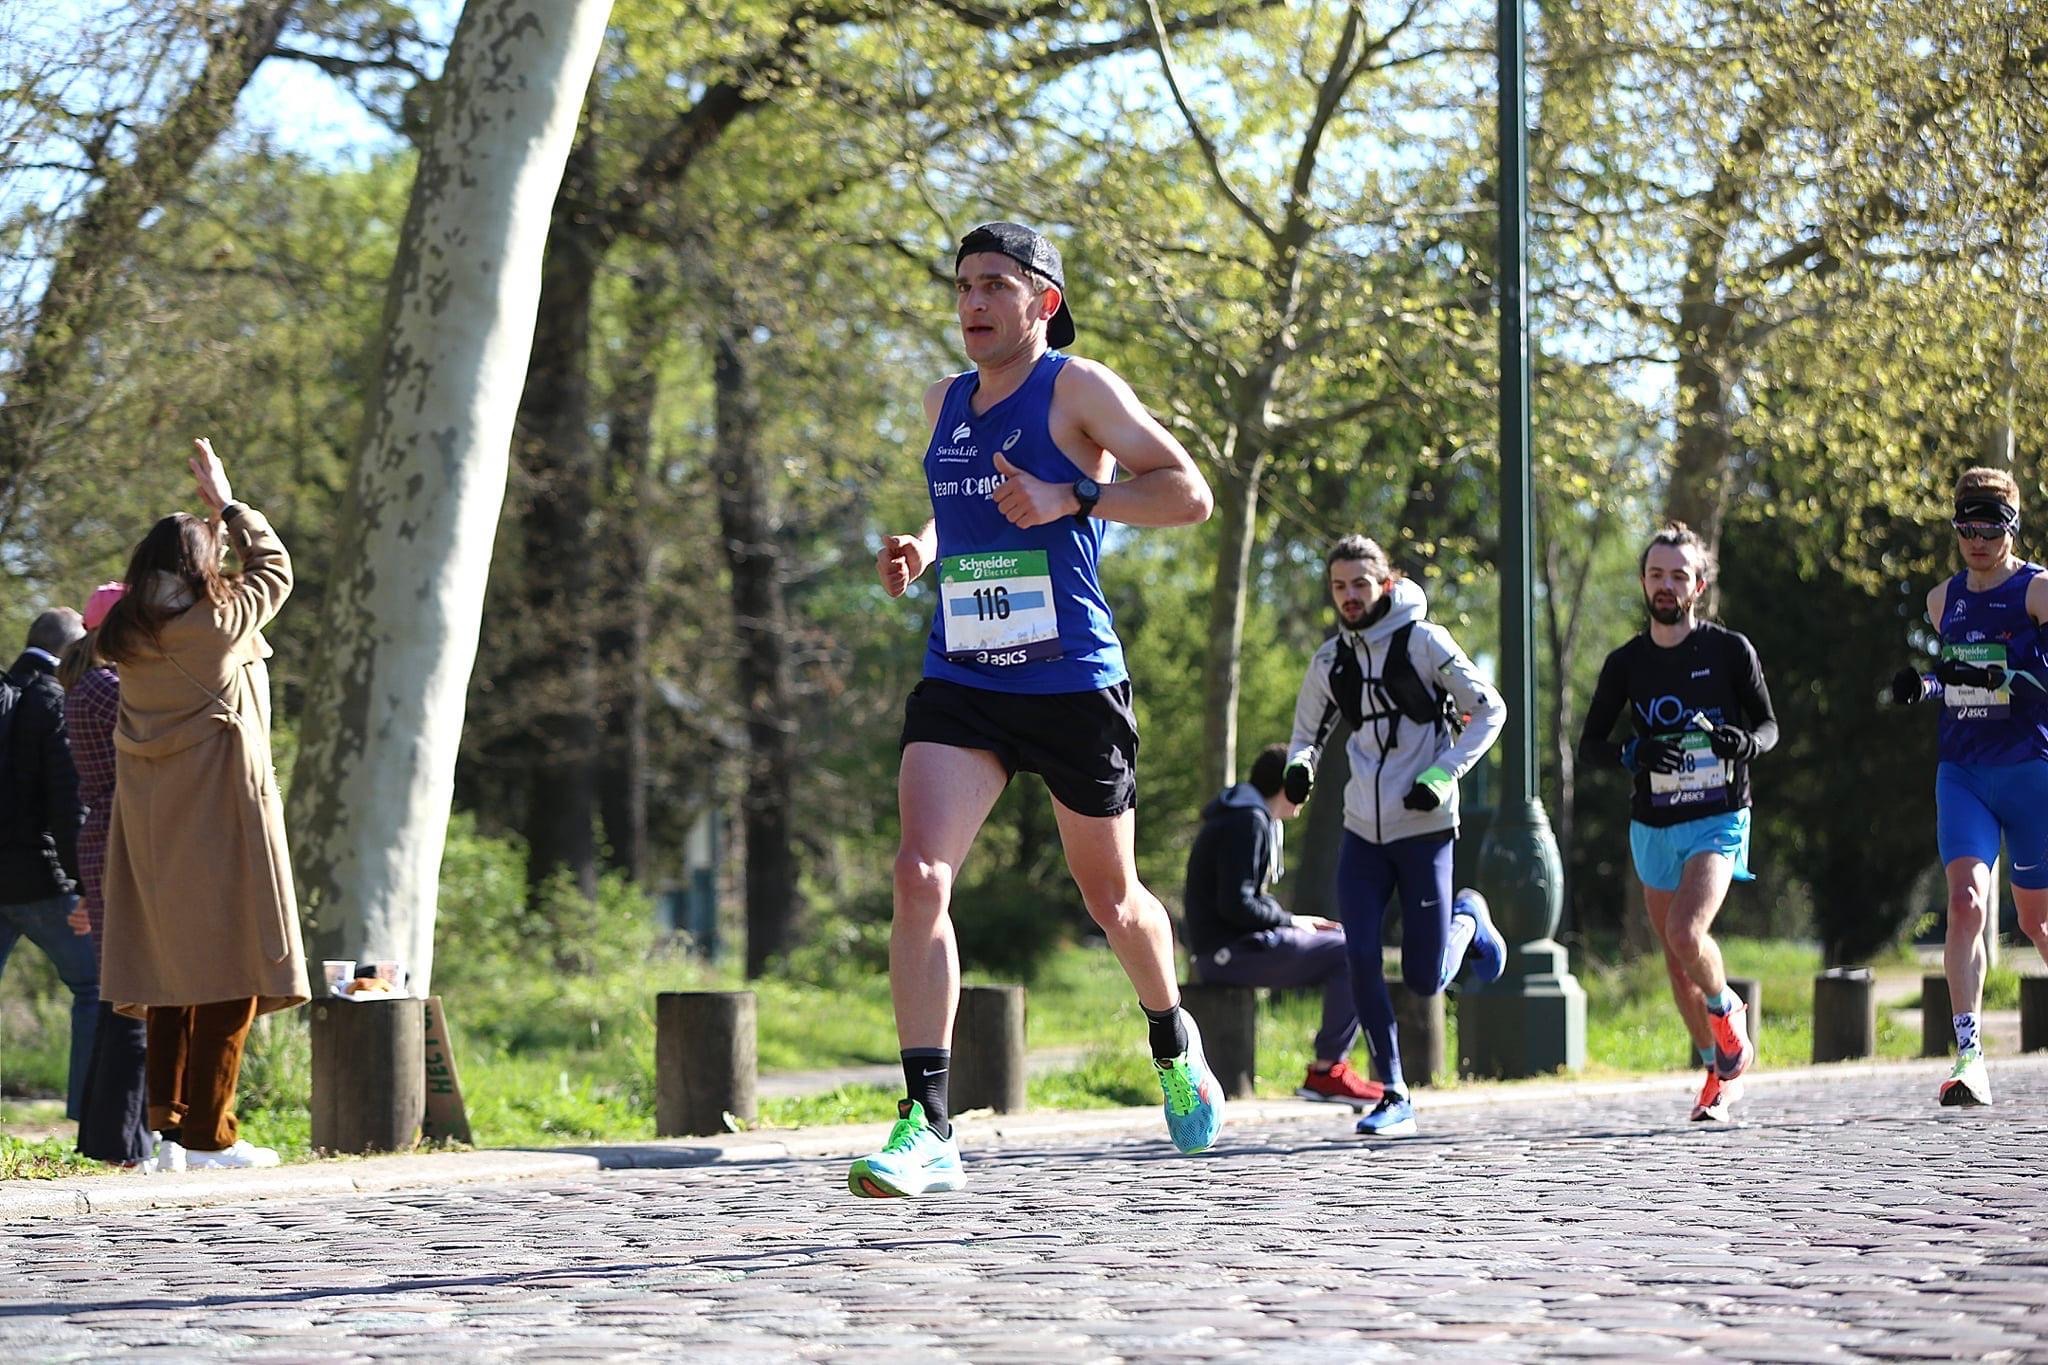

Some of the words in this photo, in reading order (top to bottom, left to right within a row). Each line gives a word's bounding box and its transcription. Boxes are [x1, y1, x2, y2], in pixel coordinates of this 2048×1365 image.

[936, 446, 978, 457] SwissLife
[933, 480, 959, 497] team
[959, 555, 1018, 571] Schneider
[983, 567, 1018, 577] Electric
[973, 586, 1010, 621] 116
